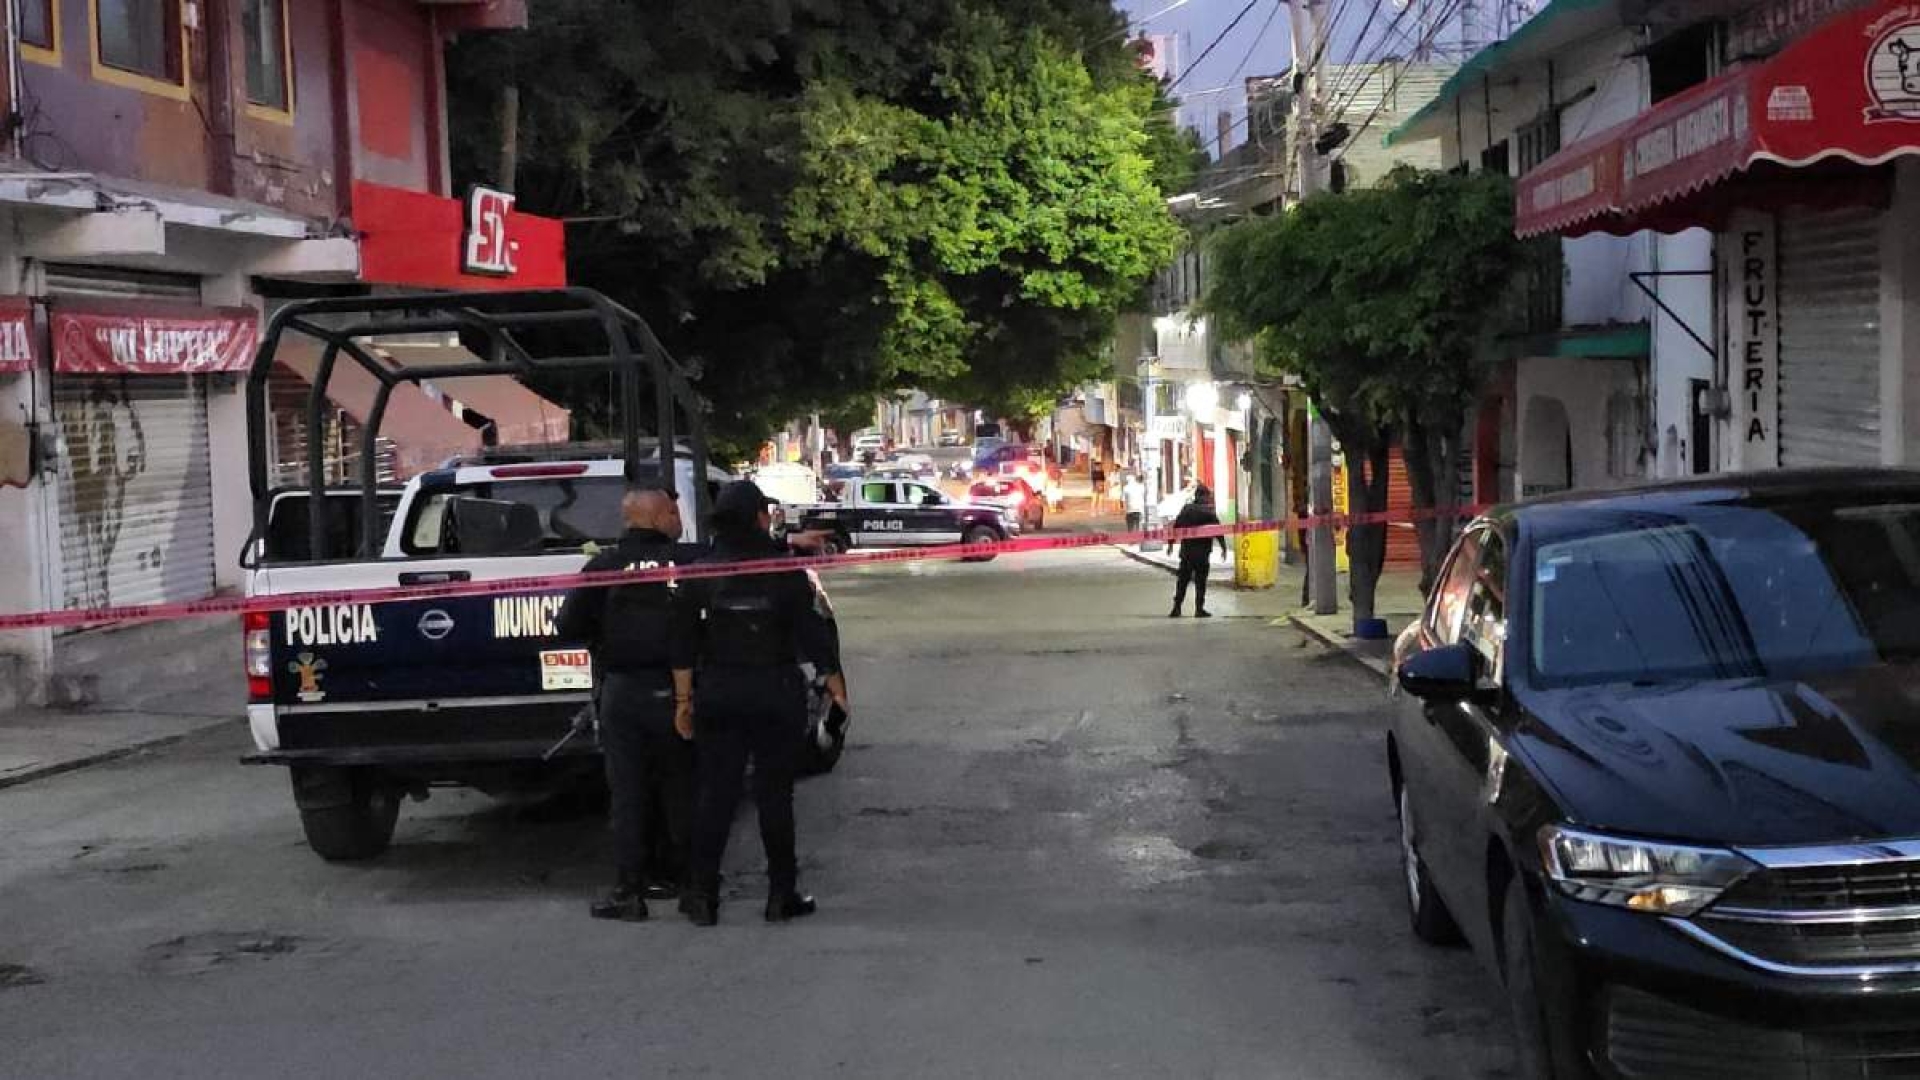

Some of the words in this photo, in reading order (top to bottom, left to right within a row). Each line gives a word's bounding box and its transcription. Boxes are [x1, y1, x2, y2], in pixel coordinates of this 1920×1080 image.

[0, 321, 31, 360] IA
[1743, 231, 1766, 443] FRUTERIA
[286, 603, 377, 646] POLICIA
